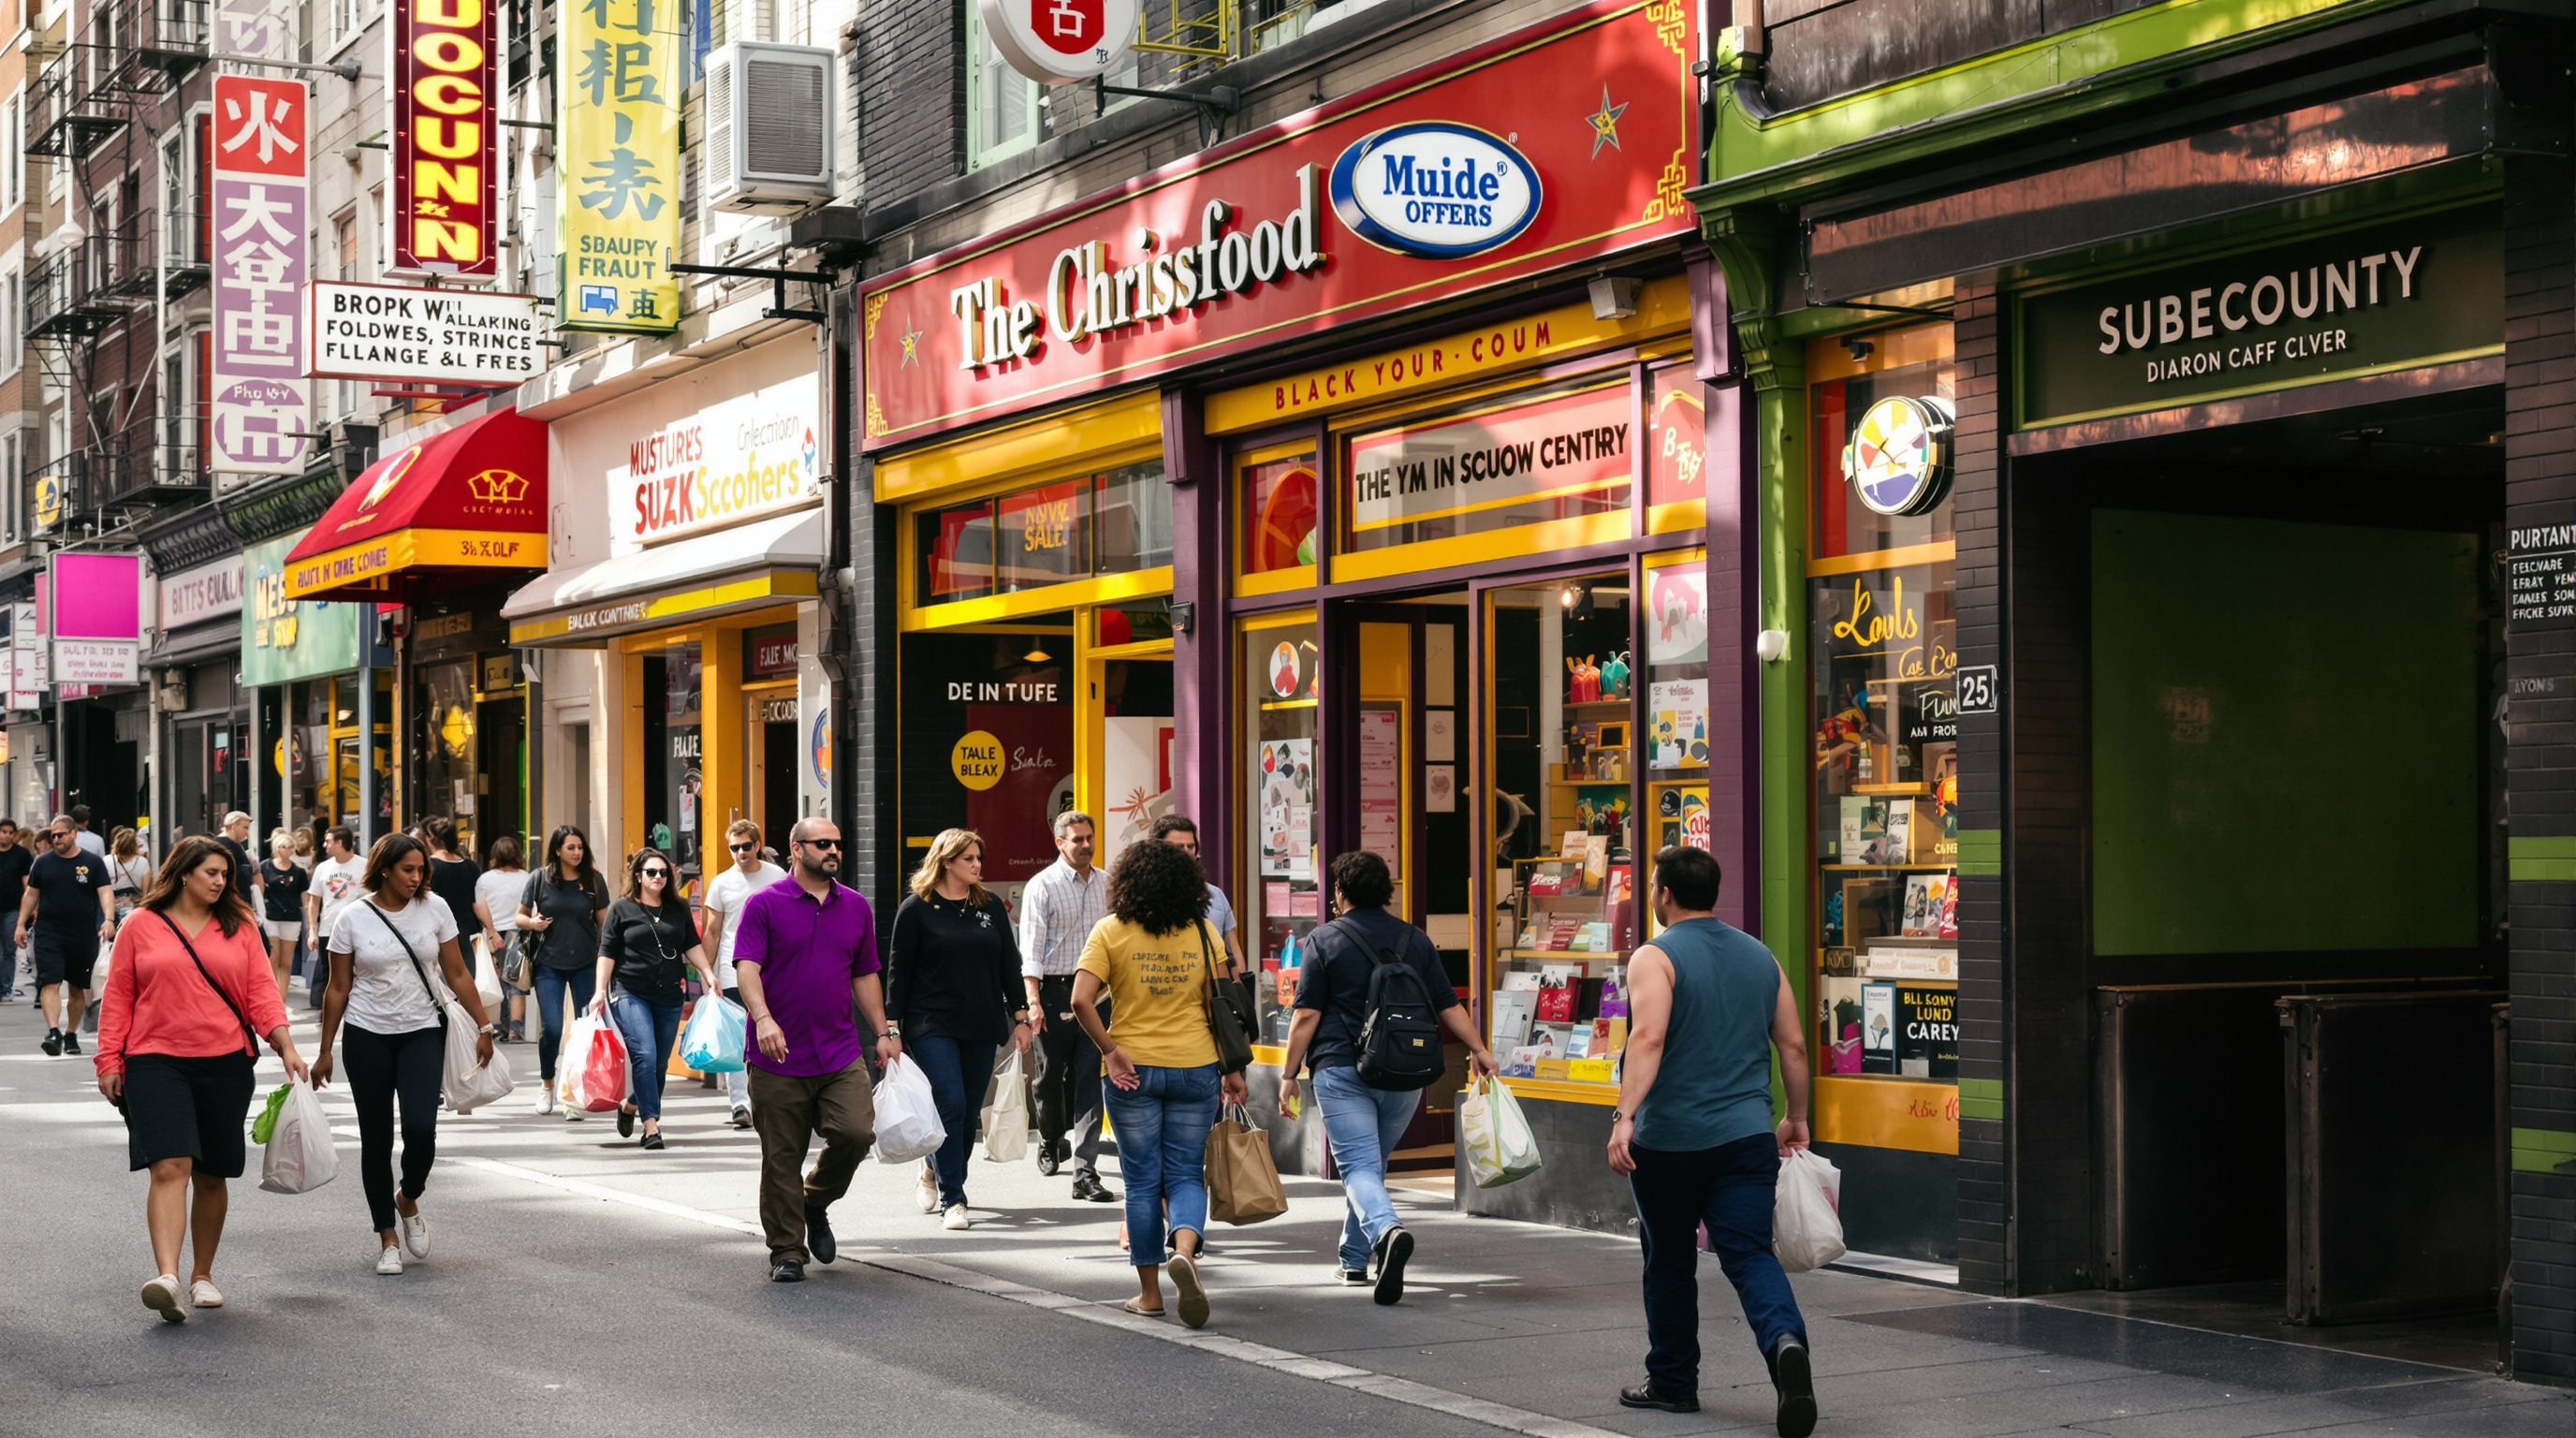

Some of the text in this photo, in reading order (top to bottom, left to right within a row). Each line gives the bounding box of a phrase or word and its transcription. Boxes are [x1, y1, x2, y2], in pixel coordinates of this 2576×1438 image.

[1383, 154, 1500, 202] Muide
[1405, 199, 1492, 227] OFFERS
[951, 161, 1326, 371] The Chrissfood
[333, 293, 413, 319] BROPK
[2099, 245, 2422, 355] SUBECOUNTY
[326, 342, 429, 365] FLLANGE
[476, 353, 533, 372] FRES
[1275, 320, 1551, 410] BLACK YOUR COUM
[2146, 329, 2347, 383] DIARON CAFF CLVER
[1355, 466, 1392, 504] THE
[1433, 455, 1455, 490] IN
[947, 682, 973, 701] DE
[978, 682, 1001, 702] IN
[1916, 1008, 1952, 1021] LUND
